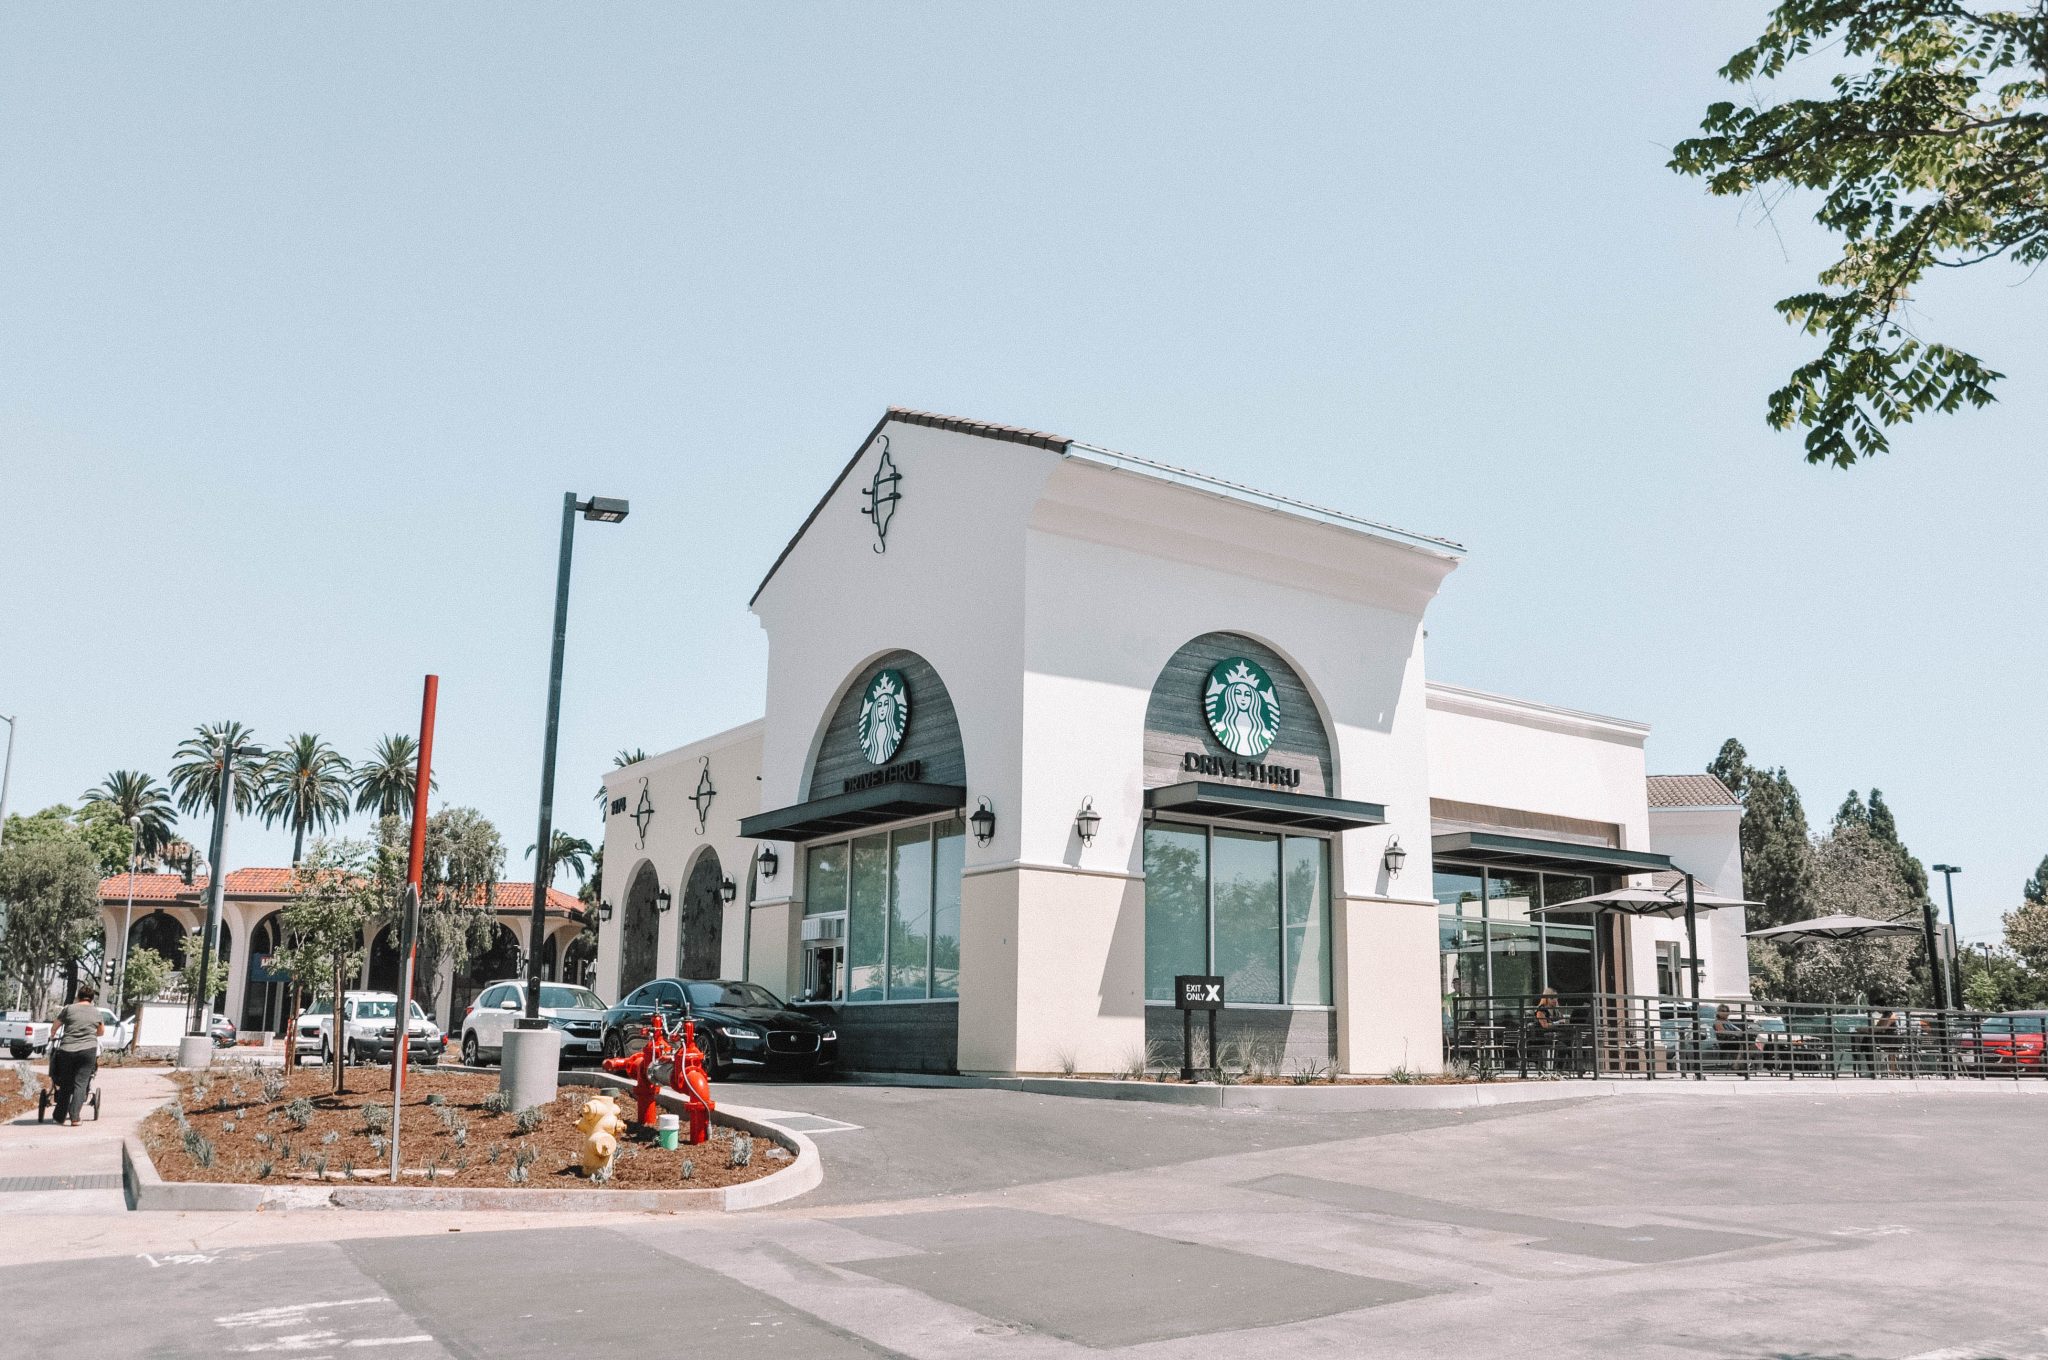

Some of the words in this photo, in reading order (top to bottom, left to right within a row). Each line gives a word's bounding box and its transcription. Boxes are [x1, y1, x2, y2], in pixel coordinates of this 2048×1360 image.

[844, 771, 880, 793] DRIVE
[880, 760, 920, 785] THRU
[1185, 752, 1246, 779] DRIVE
[1247, 762, 1300, 787] THRU
[1186, 984, 1201, 992] EXIT
[1186, 993, 1205, 1001] ONLY
